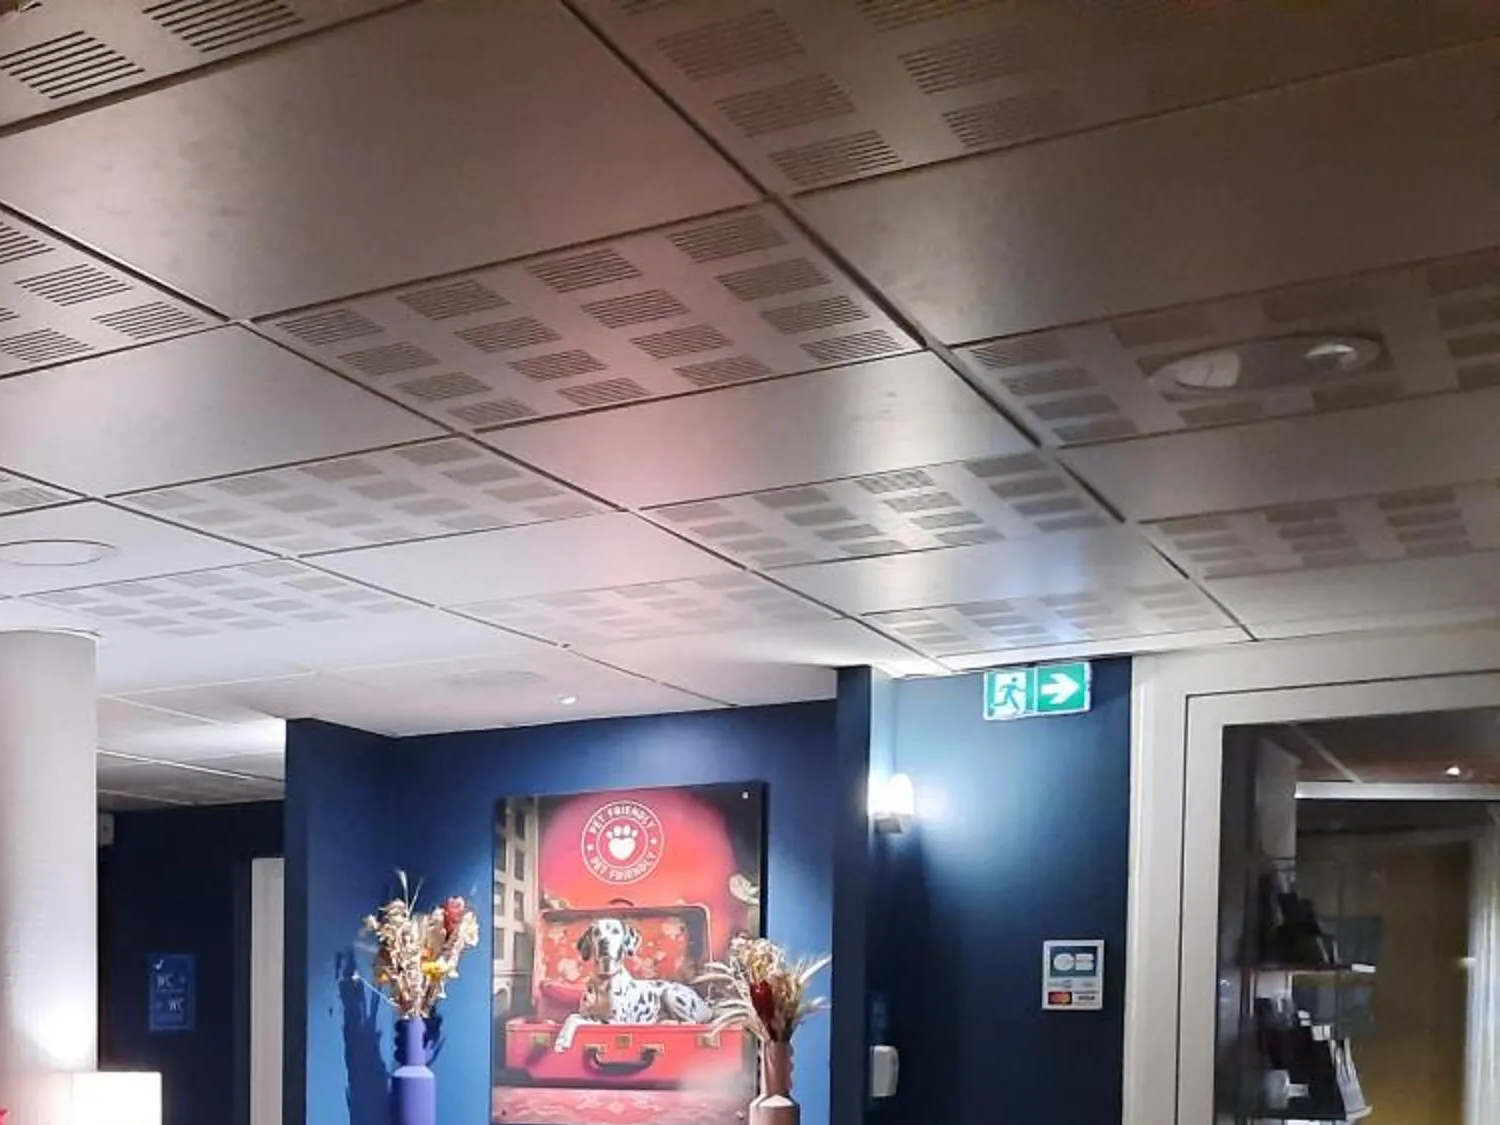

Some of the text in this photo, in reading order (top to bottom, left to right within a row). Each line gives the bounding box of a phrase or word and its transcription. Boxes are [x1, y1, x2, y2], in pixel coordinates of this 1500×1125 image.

[589, 805, 657, 834] PET FRIENDLY
[589, 851, 657, 881] PET FRIENDLY
